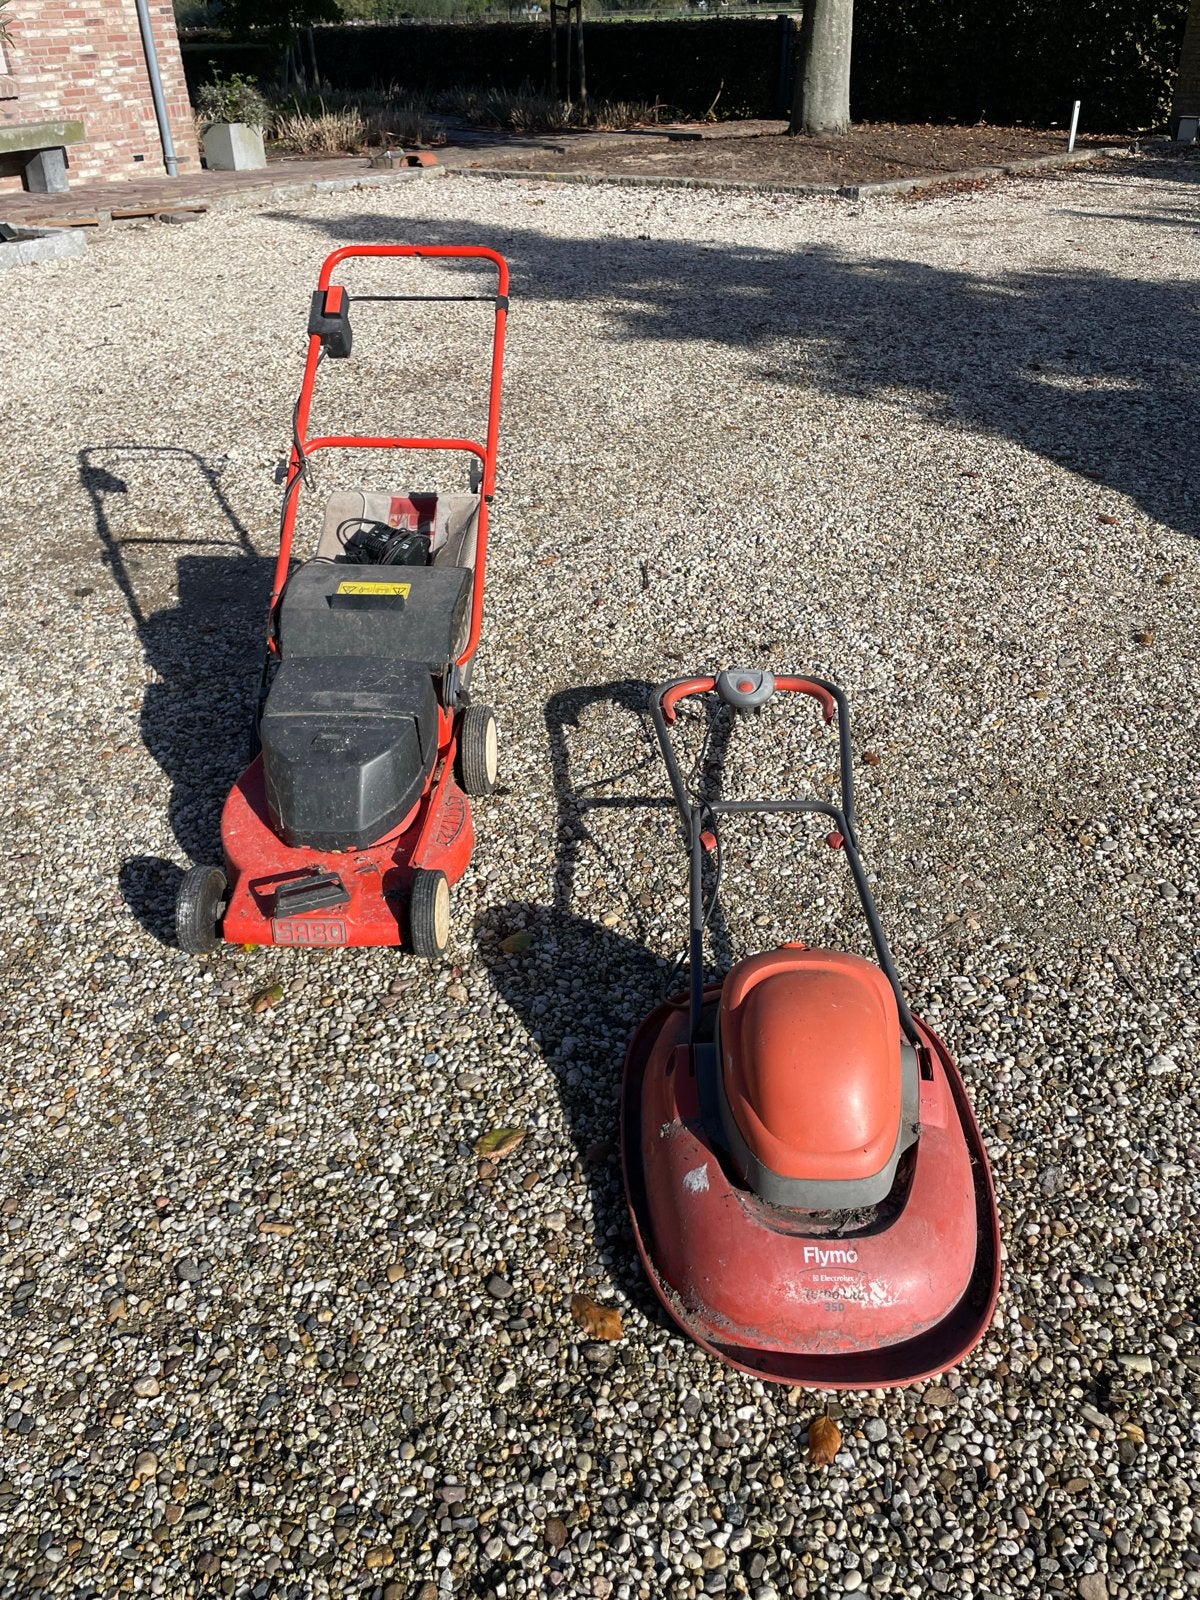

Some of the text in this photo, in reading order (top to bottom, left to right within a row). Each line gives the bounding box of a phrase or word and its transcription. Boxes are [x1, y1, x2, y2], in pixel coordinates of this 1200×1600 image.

[277, 921, 342, 942] SABO
[803, 1246, 858, 1266] Flymo
[820, 1274, 854, 1282] Electrolux
[824, 1302, 844, 1312] 350
